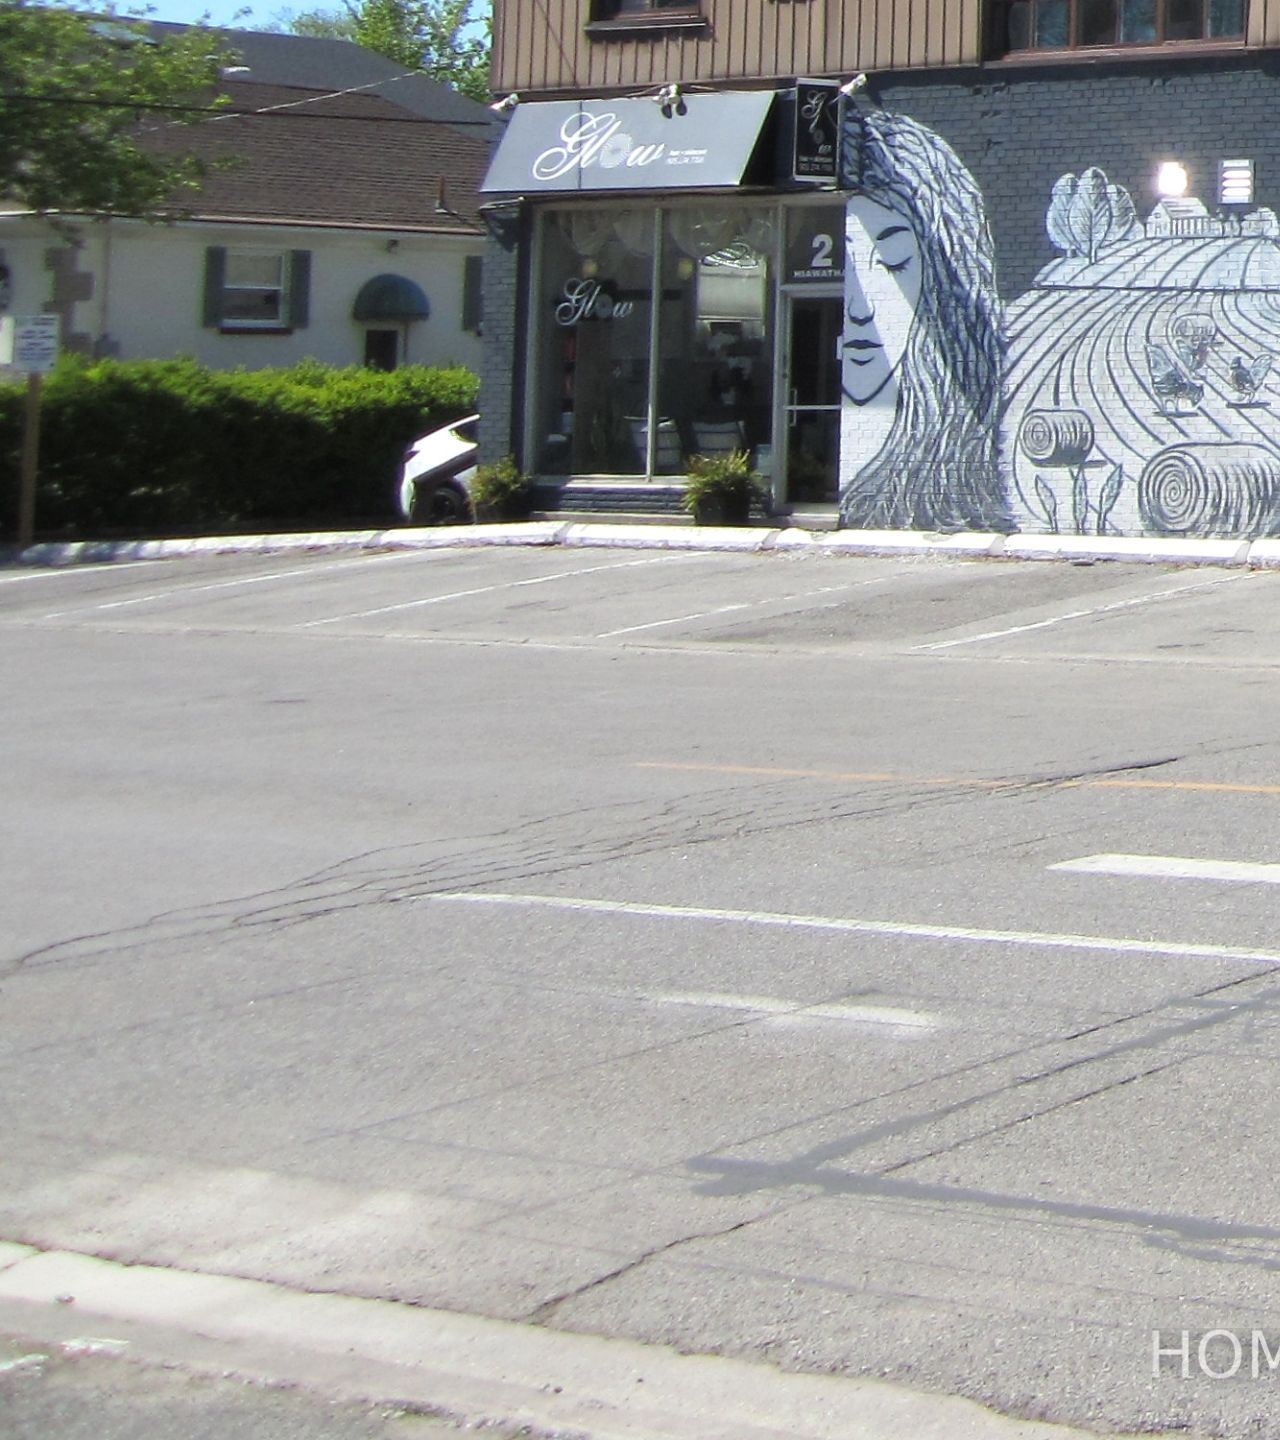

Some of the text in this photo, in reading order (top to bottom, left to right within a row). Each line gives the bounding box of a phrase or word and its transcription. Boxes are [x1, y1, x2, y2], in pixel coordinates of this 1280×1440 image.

[532, 112, 665, 180] Glow
[811, 234, 833, 267] 2
[793, 269, 845, 278] HIAWATH
[555, 278, 633, 326] Glow
